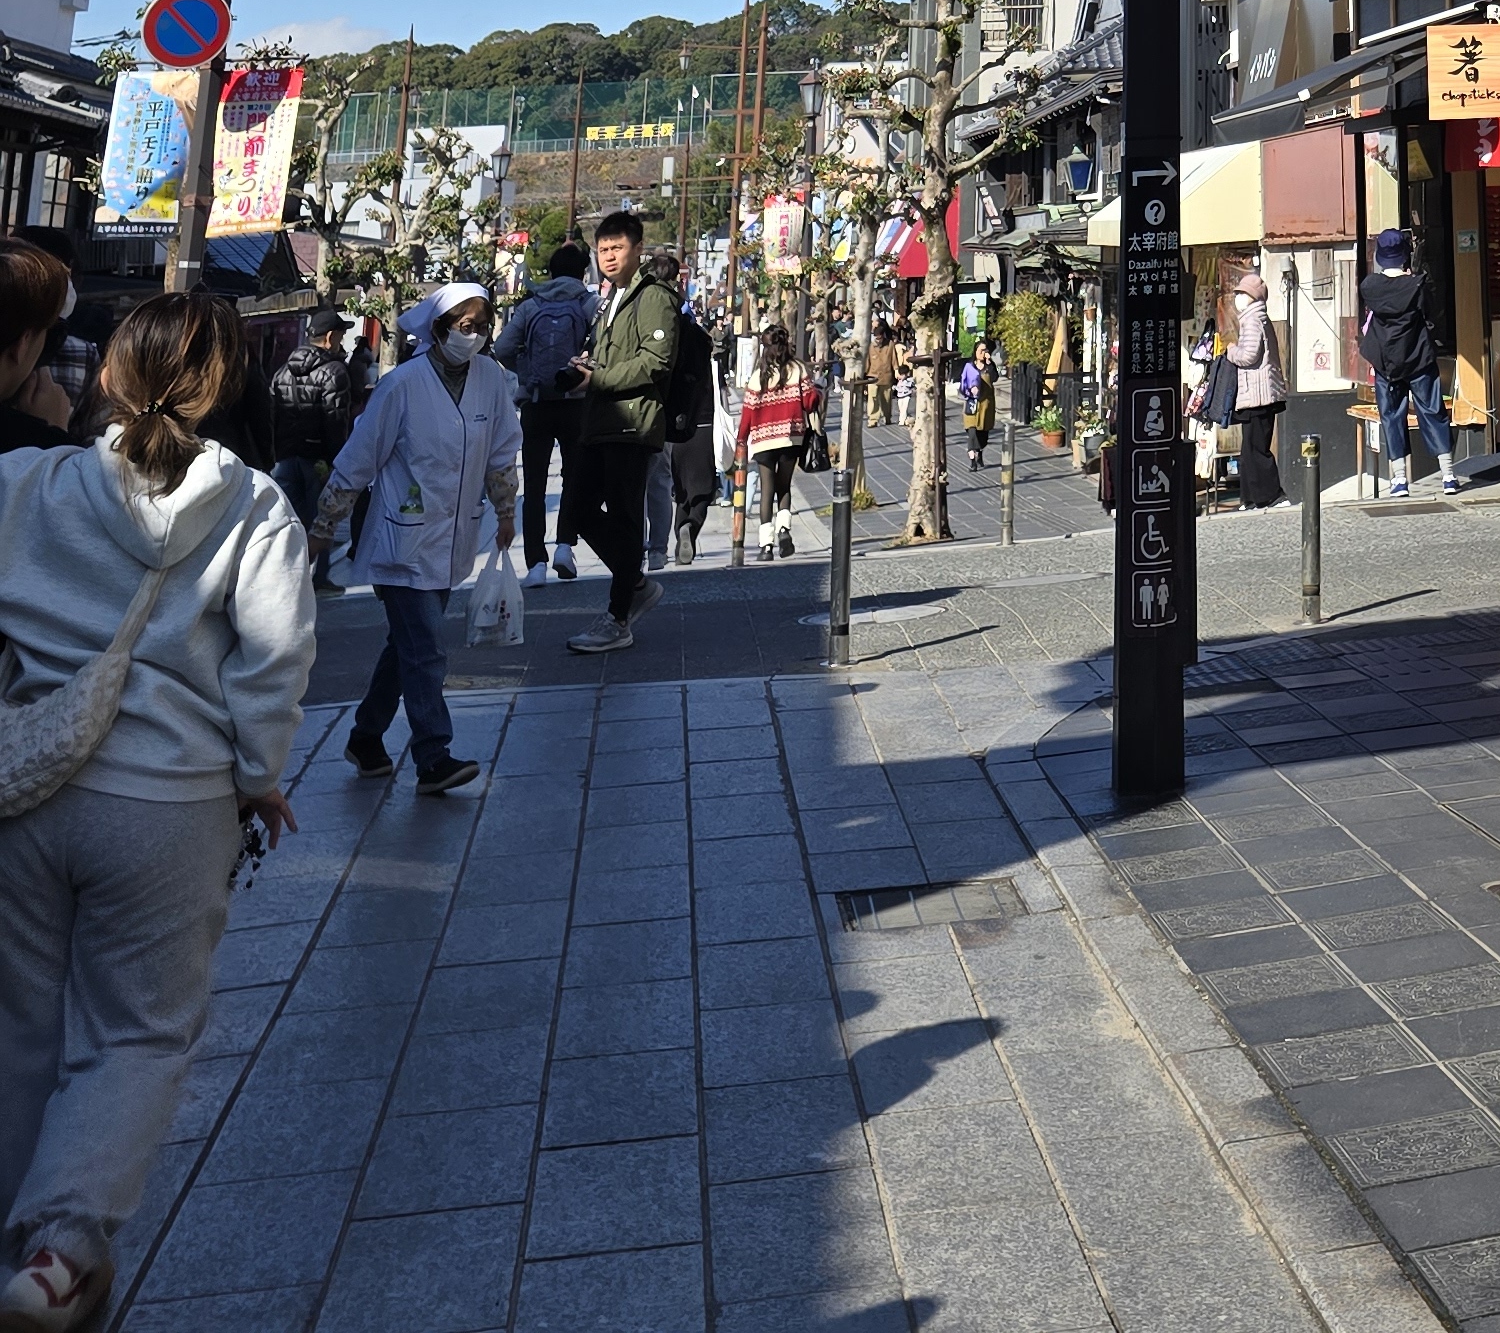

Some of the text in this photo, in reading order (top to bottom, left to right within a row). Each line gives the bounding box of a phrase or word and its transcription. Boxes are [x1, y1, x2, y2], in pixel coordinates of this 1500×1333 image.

[1128, 231, 1179, 253] 太宰府館
[1128, 260, 1161, 271] Dazaifu
